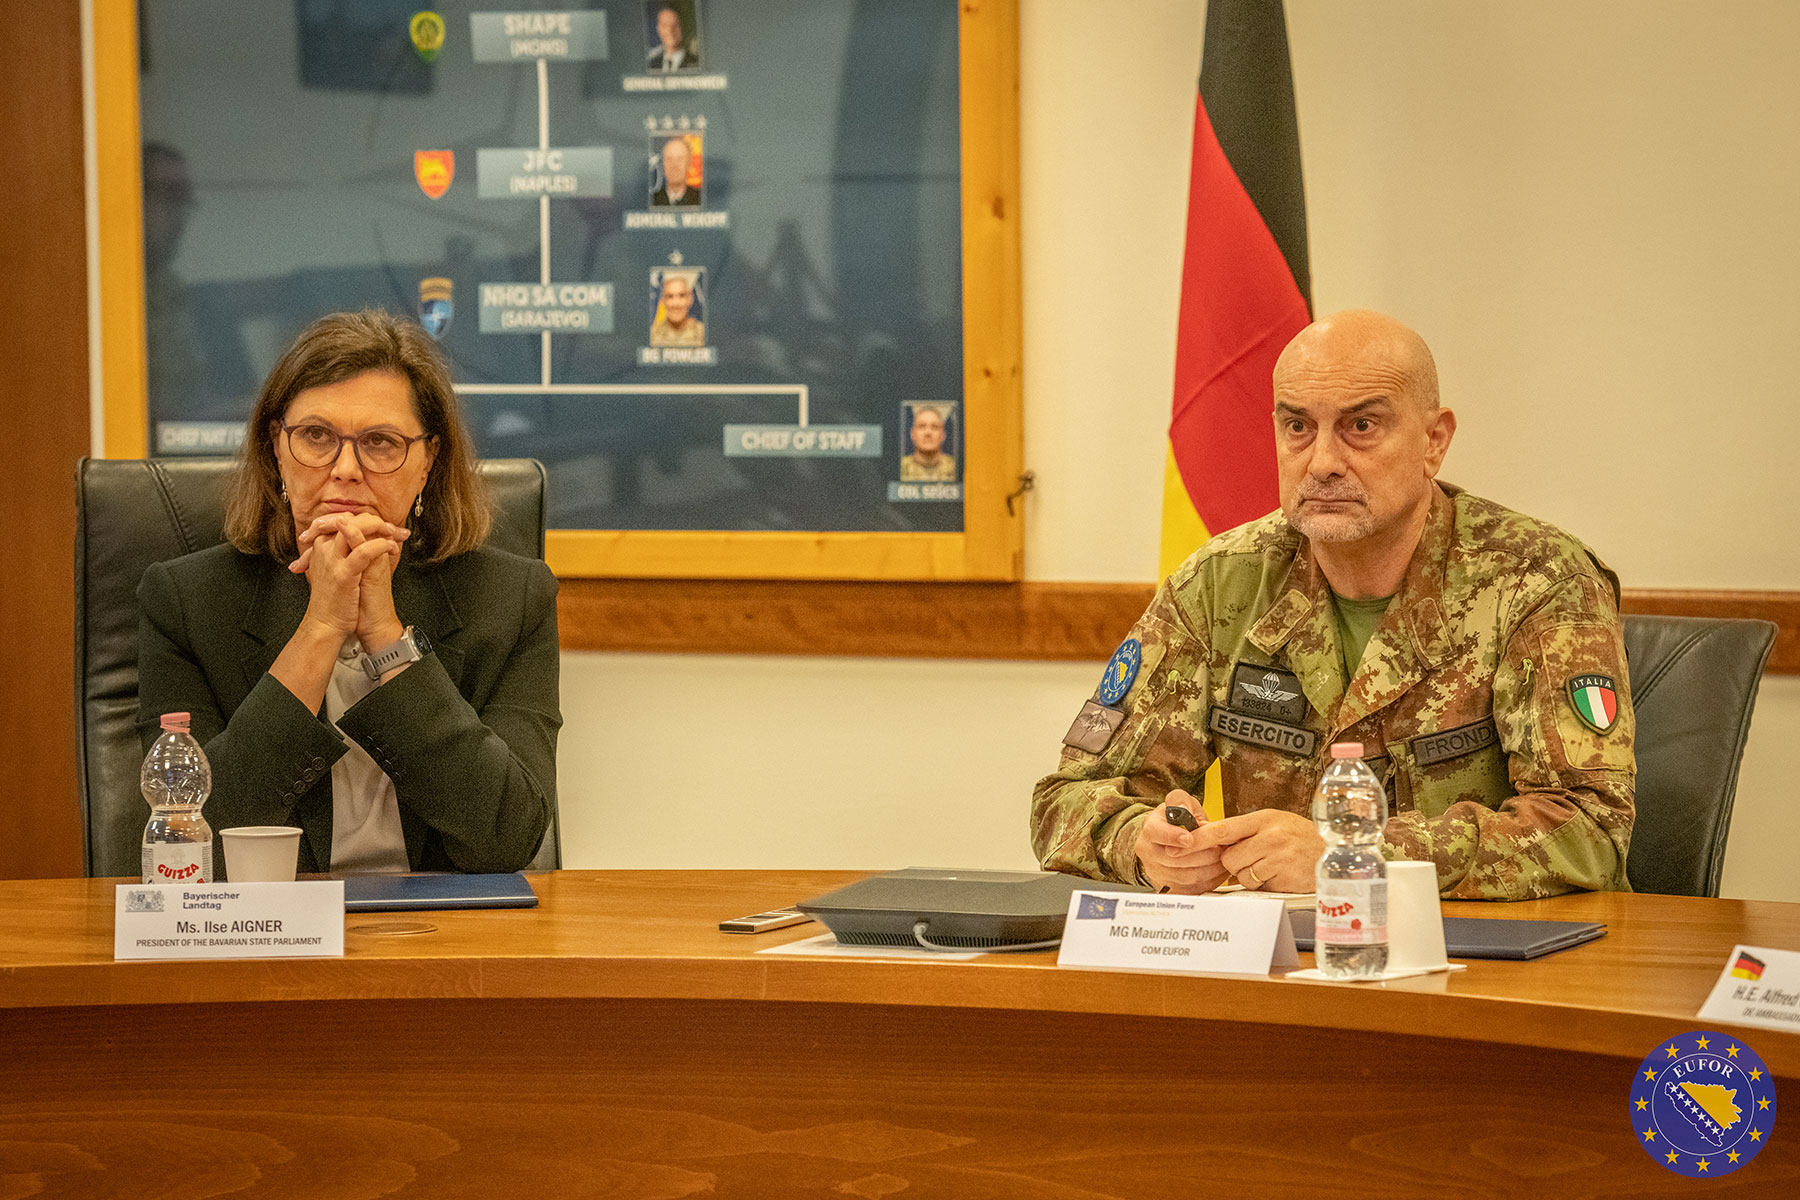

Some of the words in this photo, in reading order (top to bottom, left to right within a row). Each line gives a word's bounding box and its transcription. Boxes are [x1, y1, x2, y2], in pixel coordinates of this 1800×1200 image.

[504, 14, 571, 35] SHAPE
[522, 150, 564, 173] JFC
[483, 286, 530, 307] NHQ
[532, 286, 557, 307] SA
[559, 286, 608, 307] COM
[501, 309, 590, 329] (SARAJEVO)
[741, 431, 791, 450] CHIEF
[792, 431, 817, 450] OF
[818, 431, 866, 451] STAFF
[1574, 678, 1611, 688] ITALIA
[1217, 713, 1306, 749] ESERCITO
[1424, 726, 1492, 758] FROND
[158, 864, 200, 880] GUIZZA
[183, 892, 240, 902] Bayerischer
[183, 901, 222, 911] Landtag
[1125, 900, 1155, 909] European
[1156, 901, 1175, 909] Union
[1176, 902, 1195, 910] Force
[176, 921, 201, 934] Ms.
[204, 921, 227, 933] Ilse
[230, 919, 283, 933] AIGNER
[1109, 925, 1130, 938] MG
[1131, 926, 1180, 940] Maurizio
[1181, 929, 1230, 943] FRONDA
[136, 939, 180, 948] PRESIDENT
[180, 939, 191, 947] OF
[193, 939, 208, 947] THE
[209, 938, 248, 947] BAVARIAN
[249, 938, 272, 946] STATE
[274, 937, 322, 946] PARLIAMENT
[1141, 946, 1161, 955] COM
[1162, 946, 1191, 957] EUFOR
[1760, 989, 1800, 1007] Alfred
